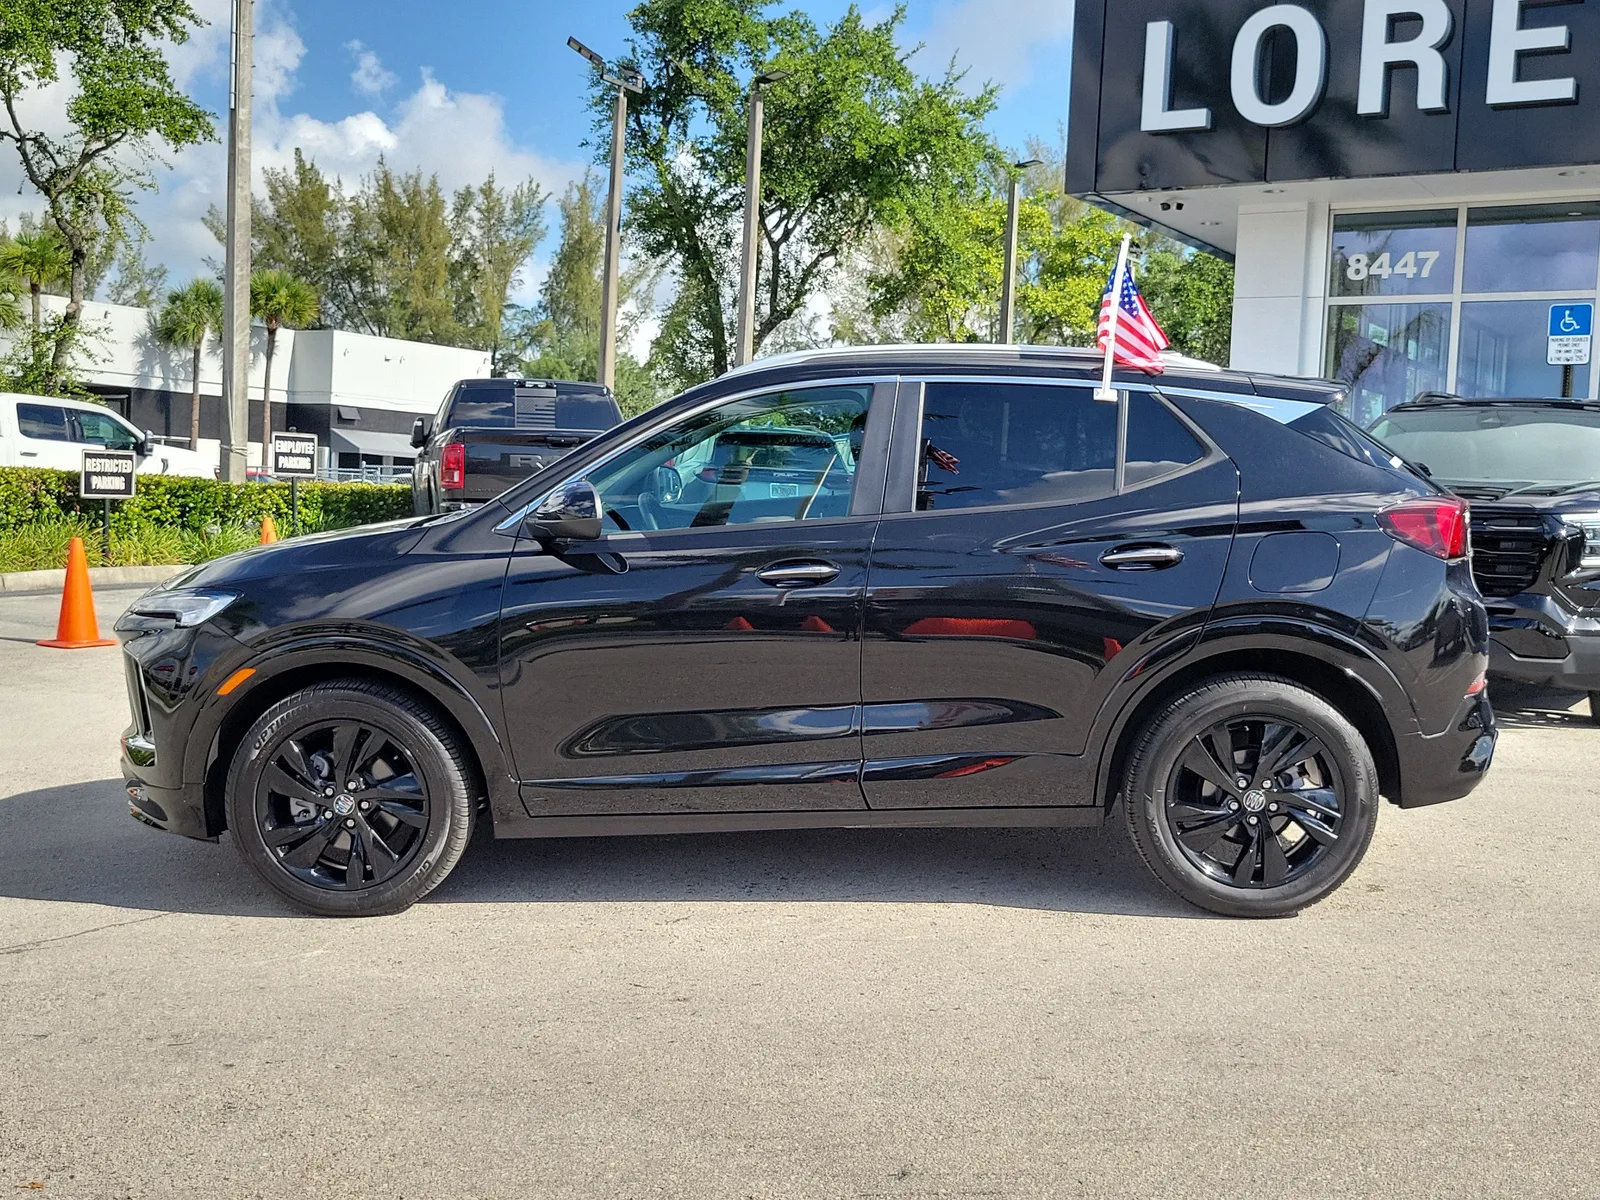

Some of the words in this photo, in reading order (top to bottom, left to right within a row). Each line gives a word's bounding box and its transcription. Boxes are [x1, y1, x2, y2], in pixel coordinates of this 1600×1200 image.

[1140, 0, 1578, 134] LORE
[1346, 251, 1440, 281] 8447
[275, 439, 314, 454] EMPLOYEE
[85, 457, 133, 473] RESTRICTED
[278, 455, 311, 470] PARKING
[91, 475, 126, 490] PARKING
